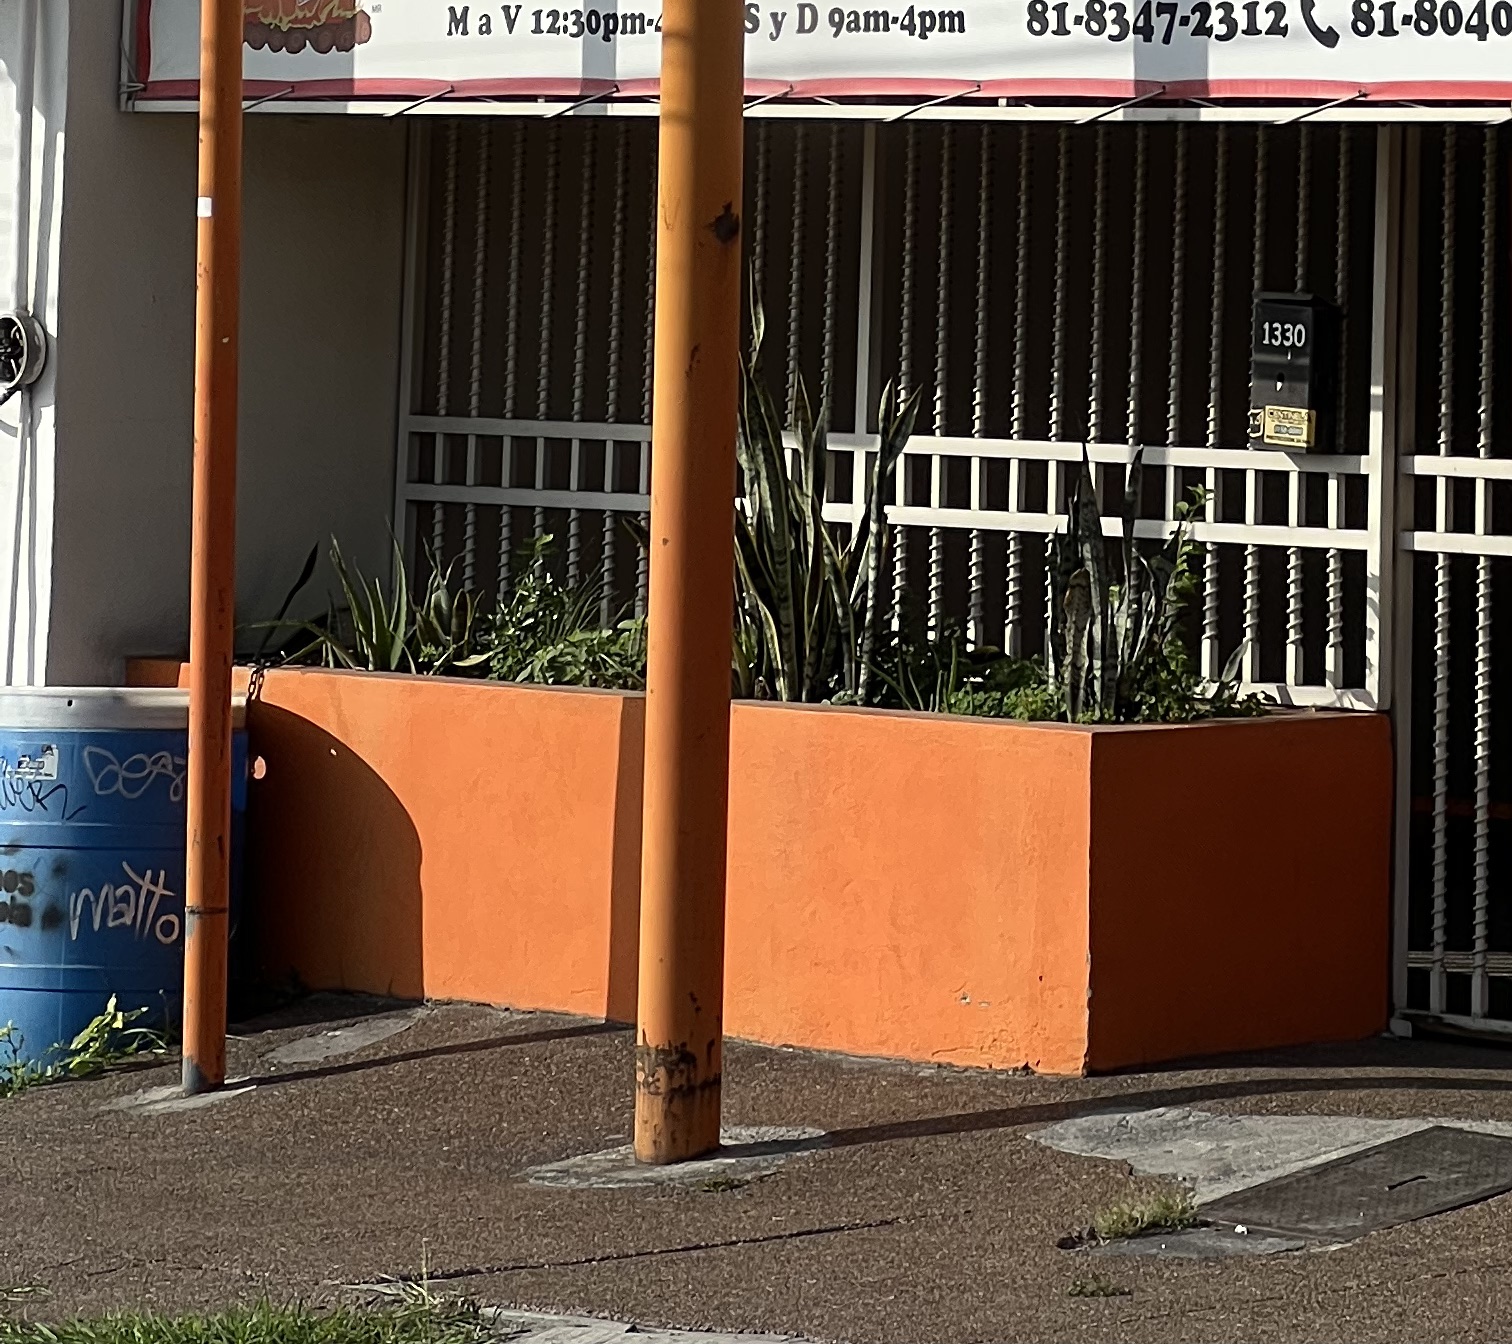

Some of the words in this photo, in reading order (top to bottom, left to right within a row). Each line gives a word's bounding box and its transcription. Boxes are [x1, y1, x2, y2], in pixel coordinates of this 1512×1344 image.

[447, 5, 470, 37] M
[478, 13, 492, 36] a
[500, 4, 523, 35] V
[744, 2, 760, 34] S
[769, 11, 787, 42] y
[796, 3, 819, 34] D
[828, 4, 966, 40] 9am-4pm
[1262, 321, 1306, 347] 1330
